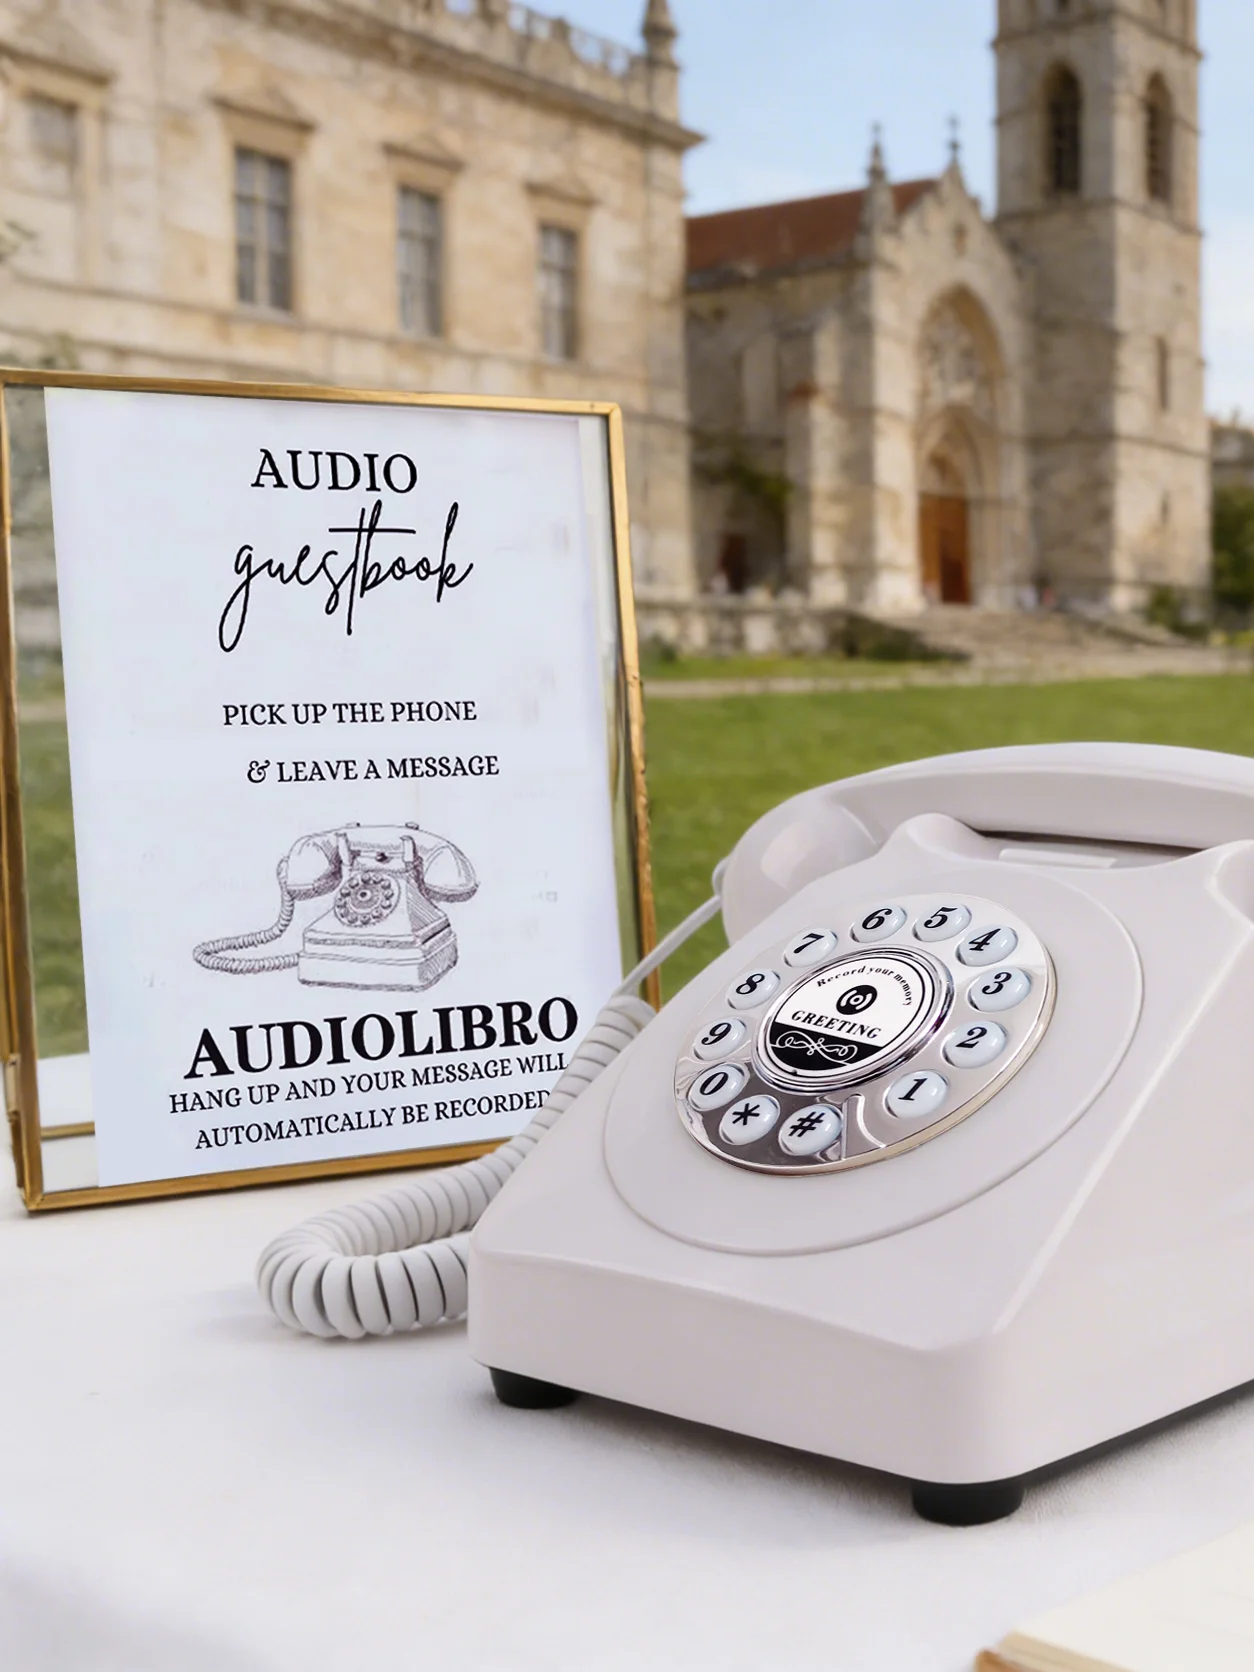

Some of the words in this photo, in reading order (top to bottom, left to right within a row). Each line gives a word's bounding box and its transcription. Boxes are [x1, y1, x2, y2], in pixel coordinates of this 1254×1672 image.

[250, 448, 418, 494] AUDIO
[218, 499, 474, 652] guestbook
[222, 703, 287, 726] PICK
[291, 703, 328, 725] UP
[332, 702, 385, 723] THE
[389, 700, 478, 722] PHONE
[246, 759, 271, 784] &
[276, 759, 359, 783] LEAVE
[363, 758, 382, 780] A
[386, 754, 500, 779] MESSAGE
[861, 907, 892, 930] 6
[924, 906, 956, 929] 5
[793, 933, 825, 954] 7
[968, 928, 1001, 952] 4
[735, 973, 765, 996] 8
[816, 965, 867, 988] Record
[867, 966, 895, 977] your
[893, 973, 913, 1007] memory
[981, 972, 1012, 996] 3
[701, 1022, 732, 1046] 9
[790, 1009, 882, 1040] GREETING
[183, 996, 579, 1080] AUDIOLIBRO
[956, 1026, 988, 1049] 2
[169, 1087, 243, 1114] HANG
[247, 1083, 281, 1106] UP
[284, 1077, 336, 1104] AND
[341, 1069, 407, 1095] YOUR
[410, 1058, 513, 1087] MESSAGE
[515, 1052, 570, 1075] WILL
[699, 1071, 729, 1096] 0
[898, 1078, 928, 1102] 1
[195, 1106, 397, 1150] AUTOMATICALLY
[400, 1103, 430, 1126] BE
